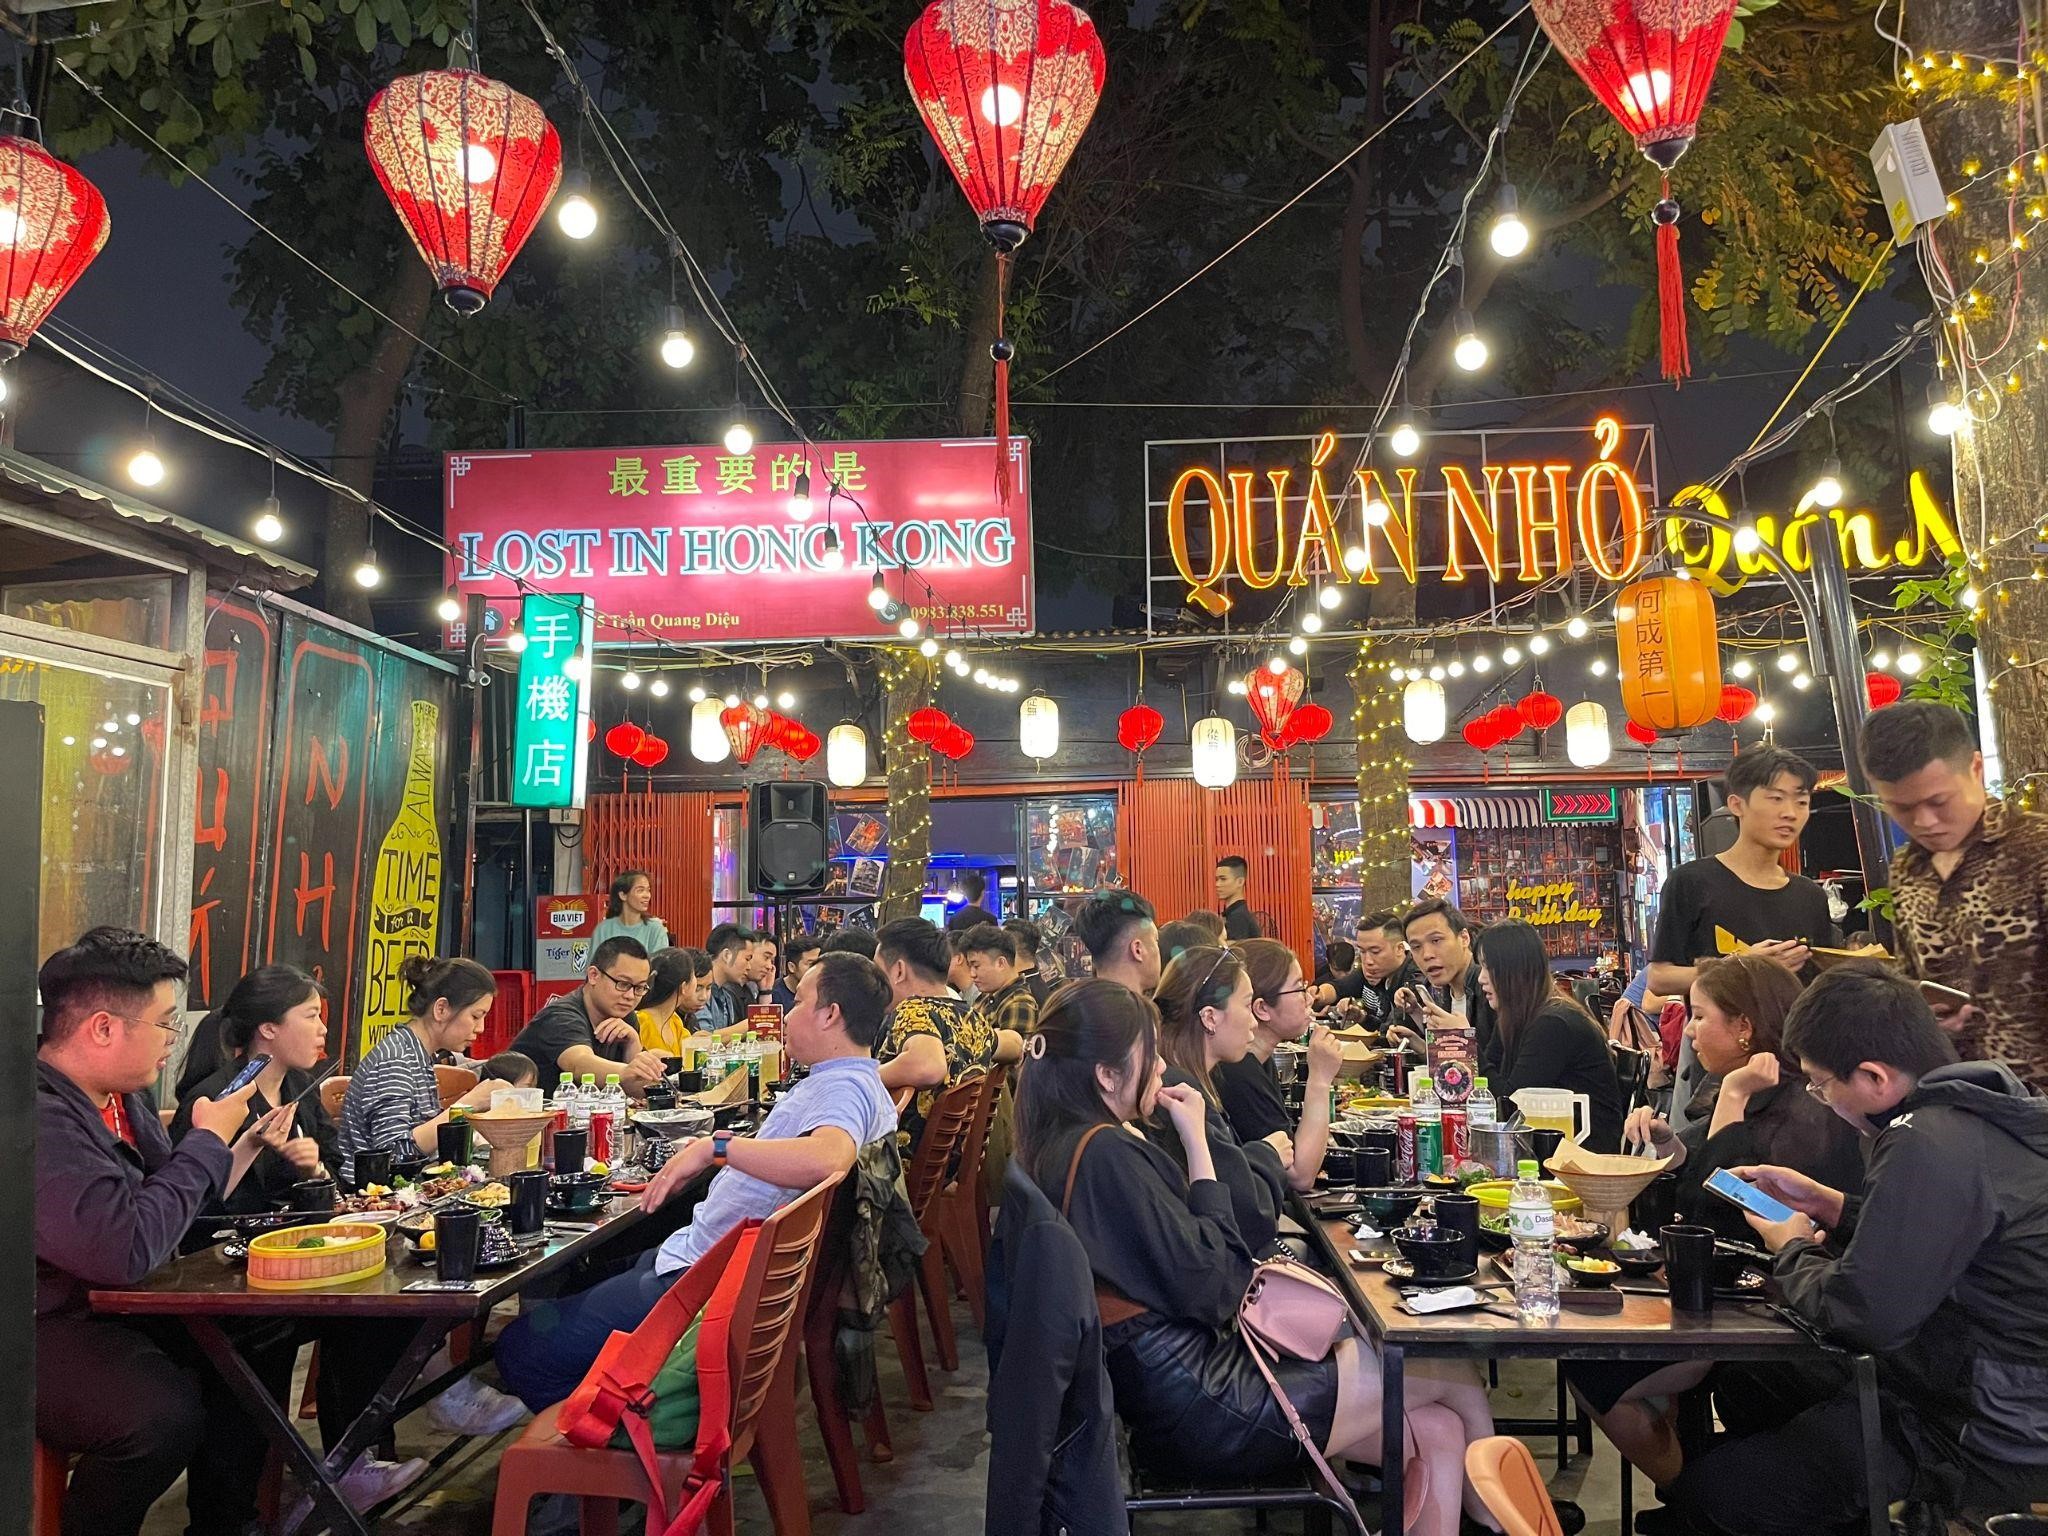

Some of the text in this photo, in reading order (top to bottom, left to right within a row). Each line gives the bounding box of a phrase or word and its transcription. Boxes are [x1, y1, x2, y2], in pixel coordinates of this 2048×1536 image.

[608, 450, 868, 496] 最重要的是
[1167, 417, 1643, 618] QUÁN NHỎ
[459, 519, 1016, 581] LOST IN HONG KONG
[610, 611, 646, 629] Trần
[650, 613, 702, 630] Quang
[705, 611, 741, 629] Diệu
[911, 604, 1005, 621] 0983.838.551
[522, 613, 573, 787] 手機店
[382, 849, 440, 904] TIME
[1505, 878, 1575, 906] happy
[553, 913, 567, 923] BIA
[546, 946, 570, 960] Tiger
[367, 938, 430, 1018] BEE
